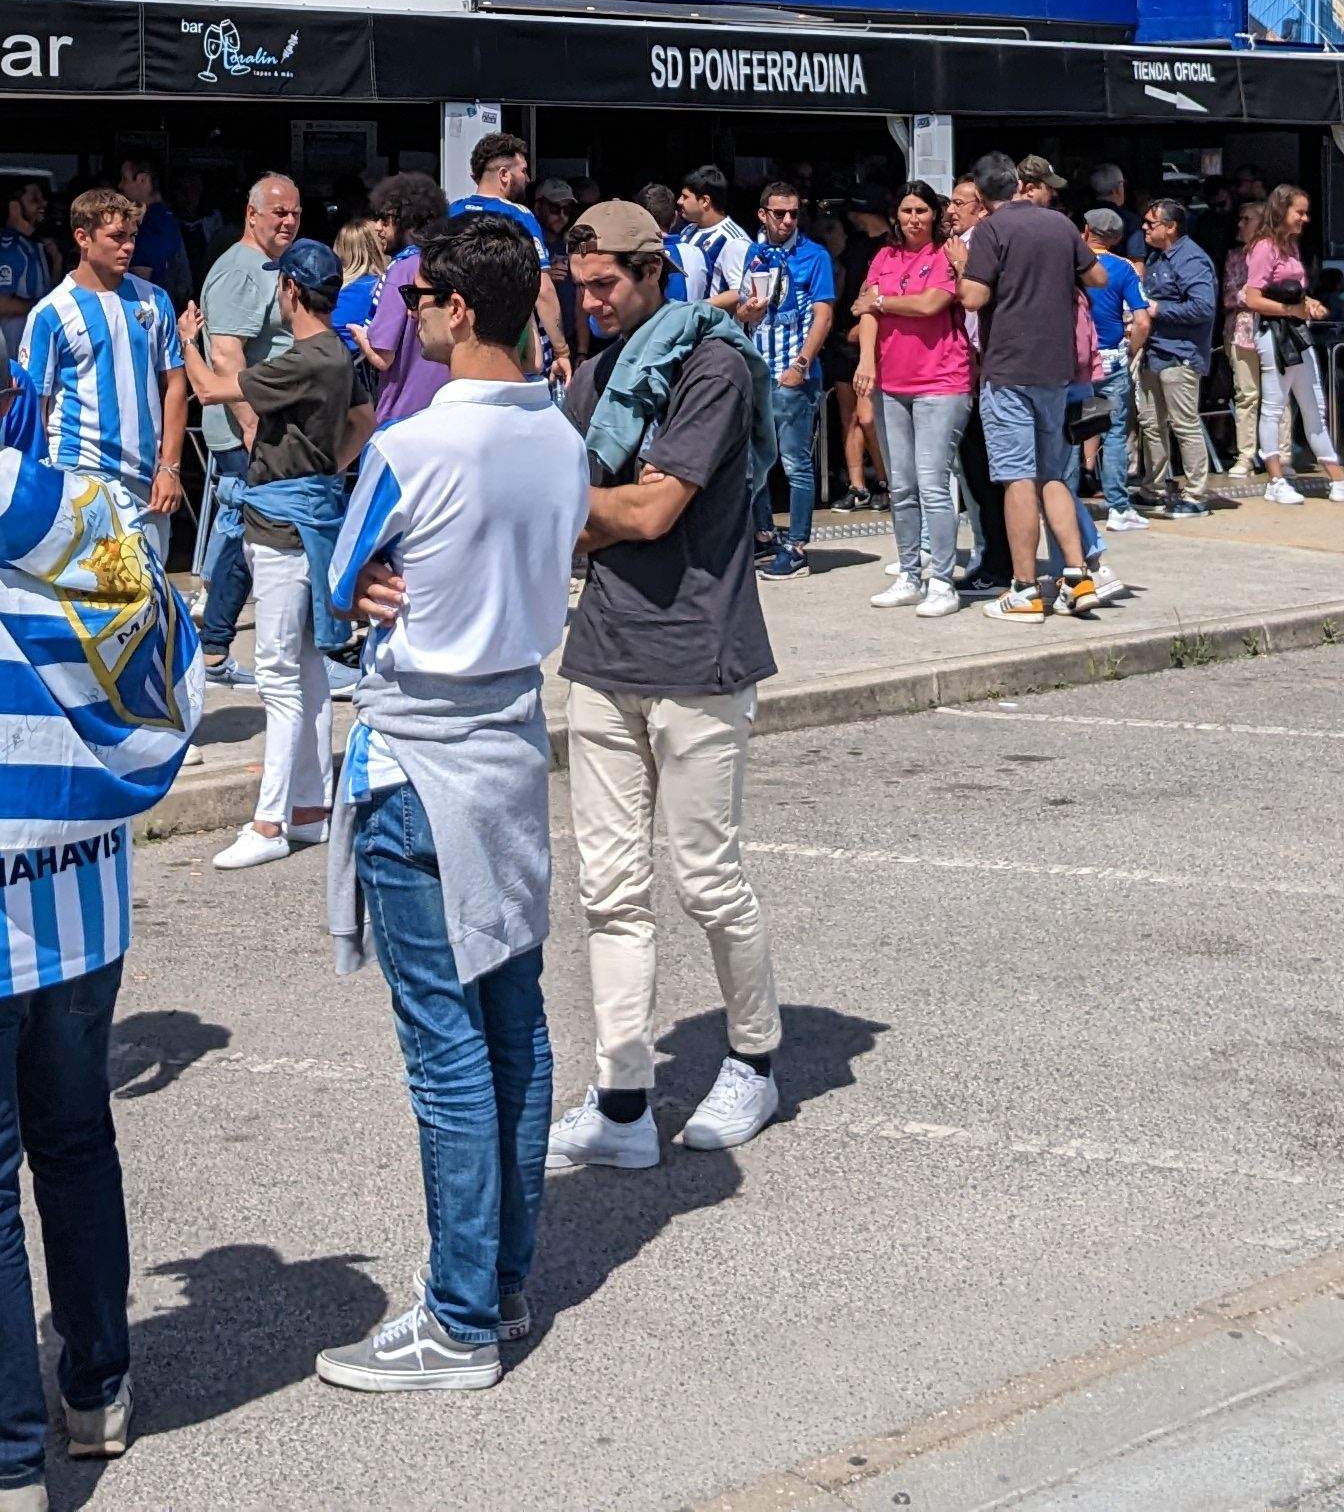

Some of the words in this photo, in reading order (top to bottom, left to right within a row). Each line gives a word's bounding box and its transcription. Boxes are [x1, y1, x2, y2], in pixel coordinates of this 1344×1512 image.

[181, 18, 203, 33] bar
[651, 44, 684, 88] SD
[690, 47, 868, 95] PONFERRADINA
[1132, 60, 1172, 81] TIENDA
[1174, 62, 1216, 82] OFICIAL
